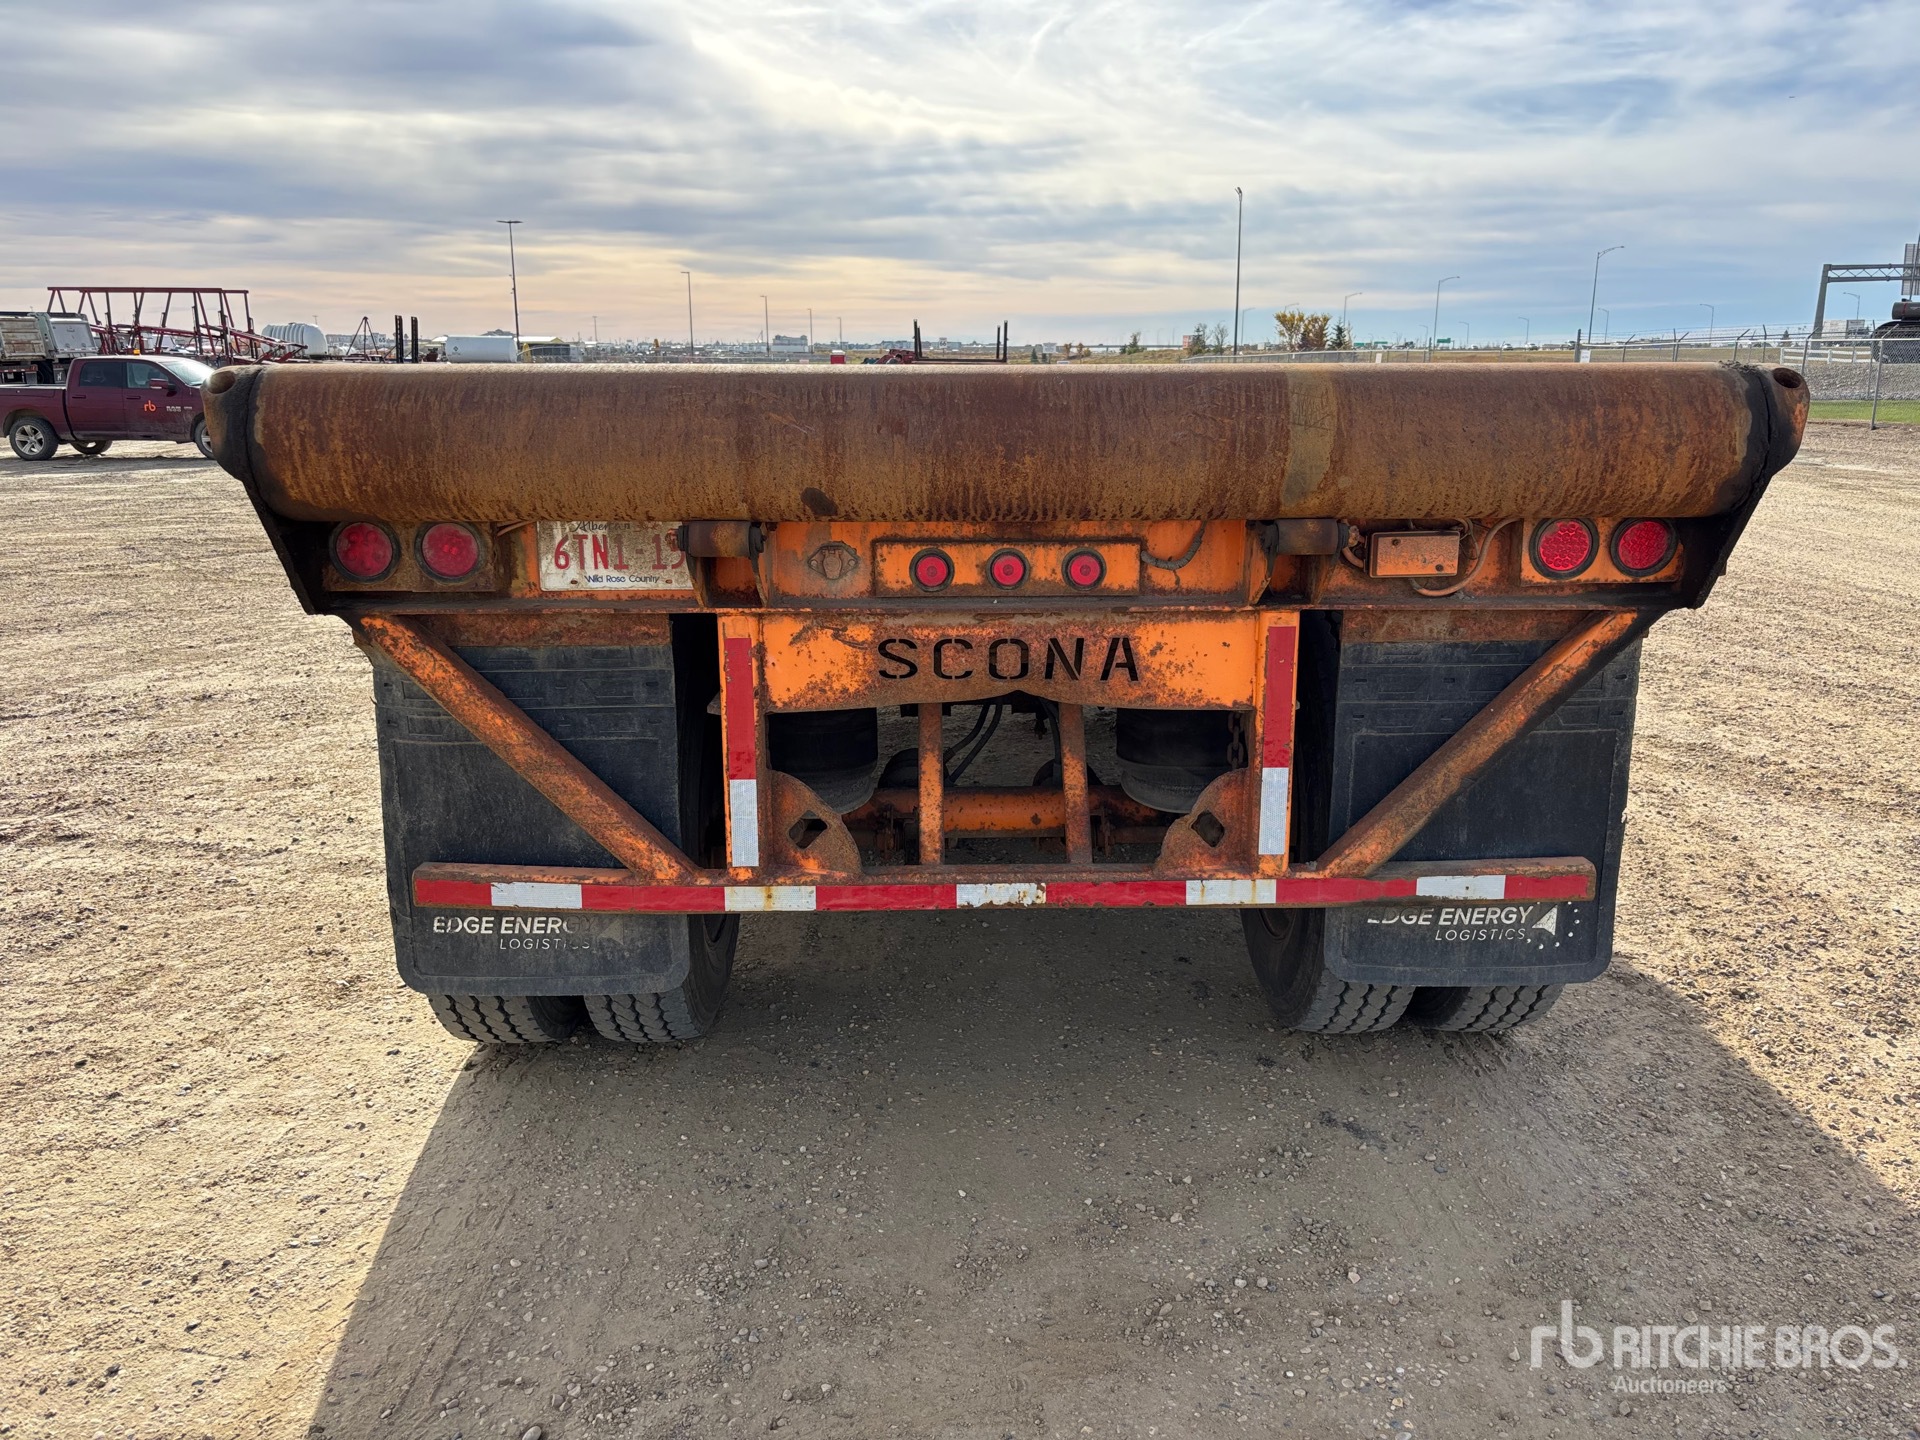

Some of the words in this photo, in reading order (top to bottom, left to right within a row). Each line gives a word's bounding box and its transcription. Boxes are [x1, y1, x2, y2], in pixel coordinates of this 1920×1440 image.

[144, 400, 156, 411] rb
[584, 575, 604, 583] Wild
[606, 575, 626, 583] Rose
[628, 575, 661, 584] Country
[877, 637, 1139, 682] SCONA
[1438, 906, 1534, 926] ENERGY
[433, 916, 495, 934] EDGE
[1434, 928, 1526, 941] LOGISTICS
